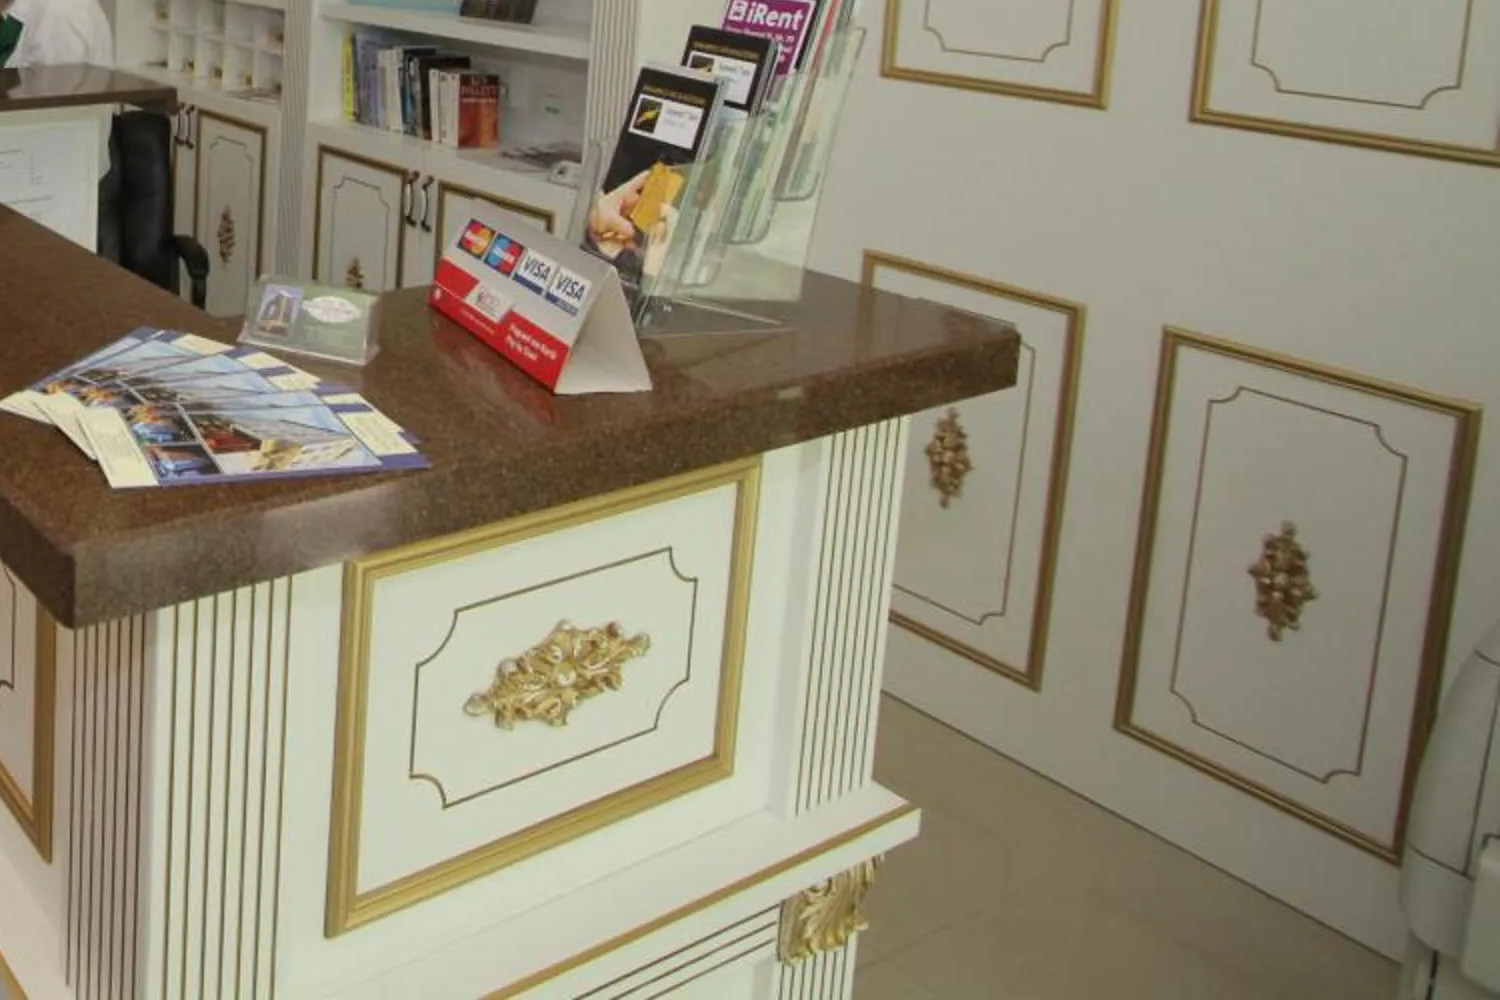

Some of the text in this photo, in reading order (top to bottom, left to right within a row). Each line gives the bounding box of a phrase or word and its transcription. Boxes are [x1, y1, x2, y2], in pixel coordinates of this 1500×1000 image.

[728, 0, 803, 31] BiRent
[524, 256, 551, 281] VISA
[556, 274, 585, 301] VISA
